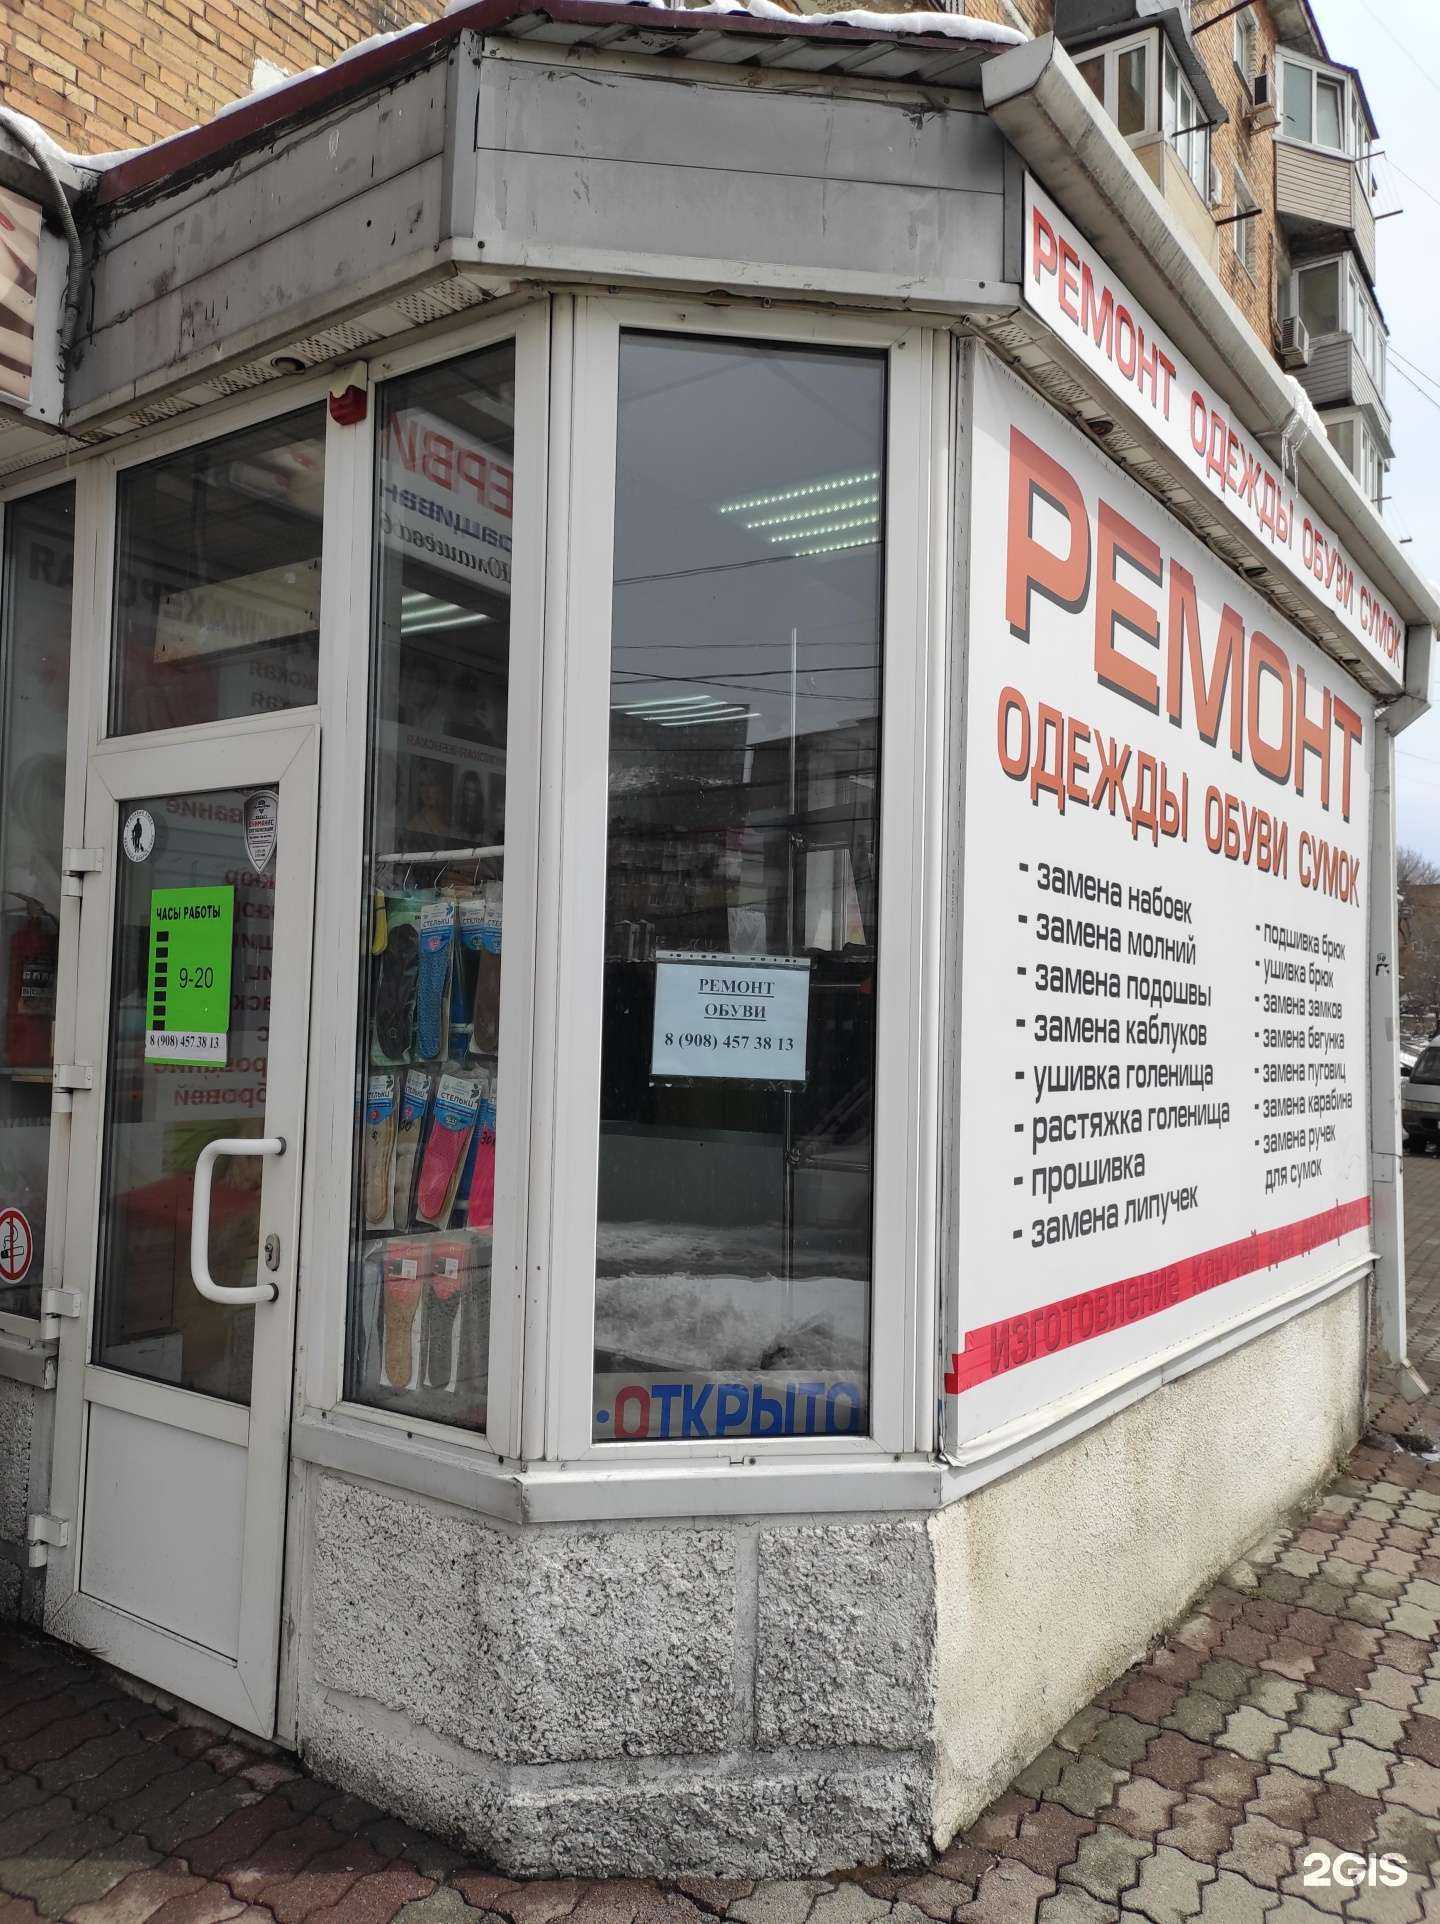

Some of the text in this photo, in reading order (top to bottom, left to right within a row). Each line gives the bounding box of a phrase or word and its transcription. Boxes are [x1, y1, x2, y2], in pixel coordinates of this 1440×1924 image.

[1032, 206, 1401, 669] РЕМОНТ ОДЕЖДЫ ОБУВИ СУМОК
[1005, 424, 1363, 823] РЕМОНТ
[997, 686, 1361, 907] ОДЕЖДЫ ОБУВИ СУМОК
[1037, 862, 1192, 924] замена набоек
[156, 906, 181, 921] ЧАСЫ
[183, 905, 221, 920] РАБОТЫ
[1036, 913, 1196, 965] замена молний
[1264, 923, 1345, 963] подшивка брюк
[179, 967, 214, 989] 9-20
[698, 978, 775, 996] РЕМОНТ
[1035, 964, 1211, 1008] замена подошвы
[1264, 958, 1334, 992] ушивка брюк
[705, 1003, 767, 1019] ОБУВИ
[1263, 994, 1343, 1019] замена замков
[149, 1034, 220, 1049] 8 (908) 457 38 13
[664, 1033, 794, 1051] 8 (908) 457 38 13
[1034, 1013, 1207, 1054] замена каблуков
[1263, 1025, 1345, 1055] замена бегунка
[1033, 1064, 1213, 1104] ушивка голенища
[1263, 1063, 1346, 1087] замена пуговиц
[1263, 1088, 1352, 1118] замена карабина
[1032, 1102, 1230, 1155] растяжка голенища
[1263, 1124, 1336, 1153] замена ручек
[1032, 1152, 1145, 1204] прошивка
[1265, 1159, 1322, 1195] для сумок
[1032, 1185, 1198, 1248] замена липучек
[614, 1382, 861, 1439] ОТКРЫТО
